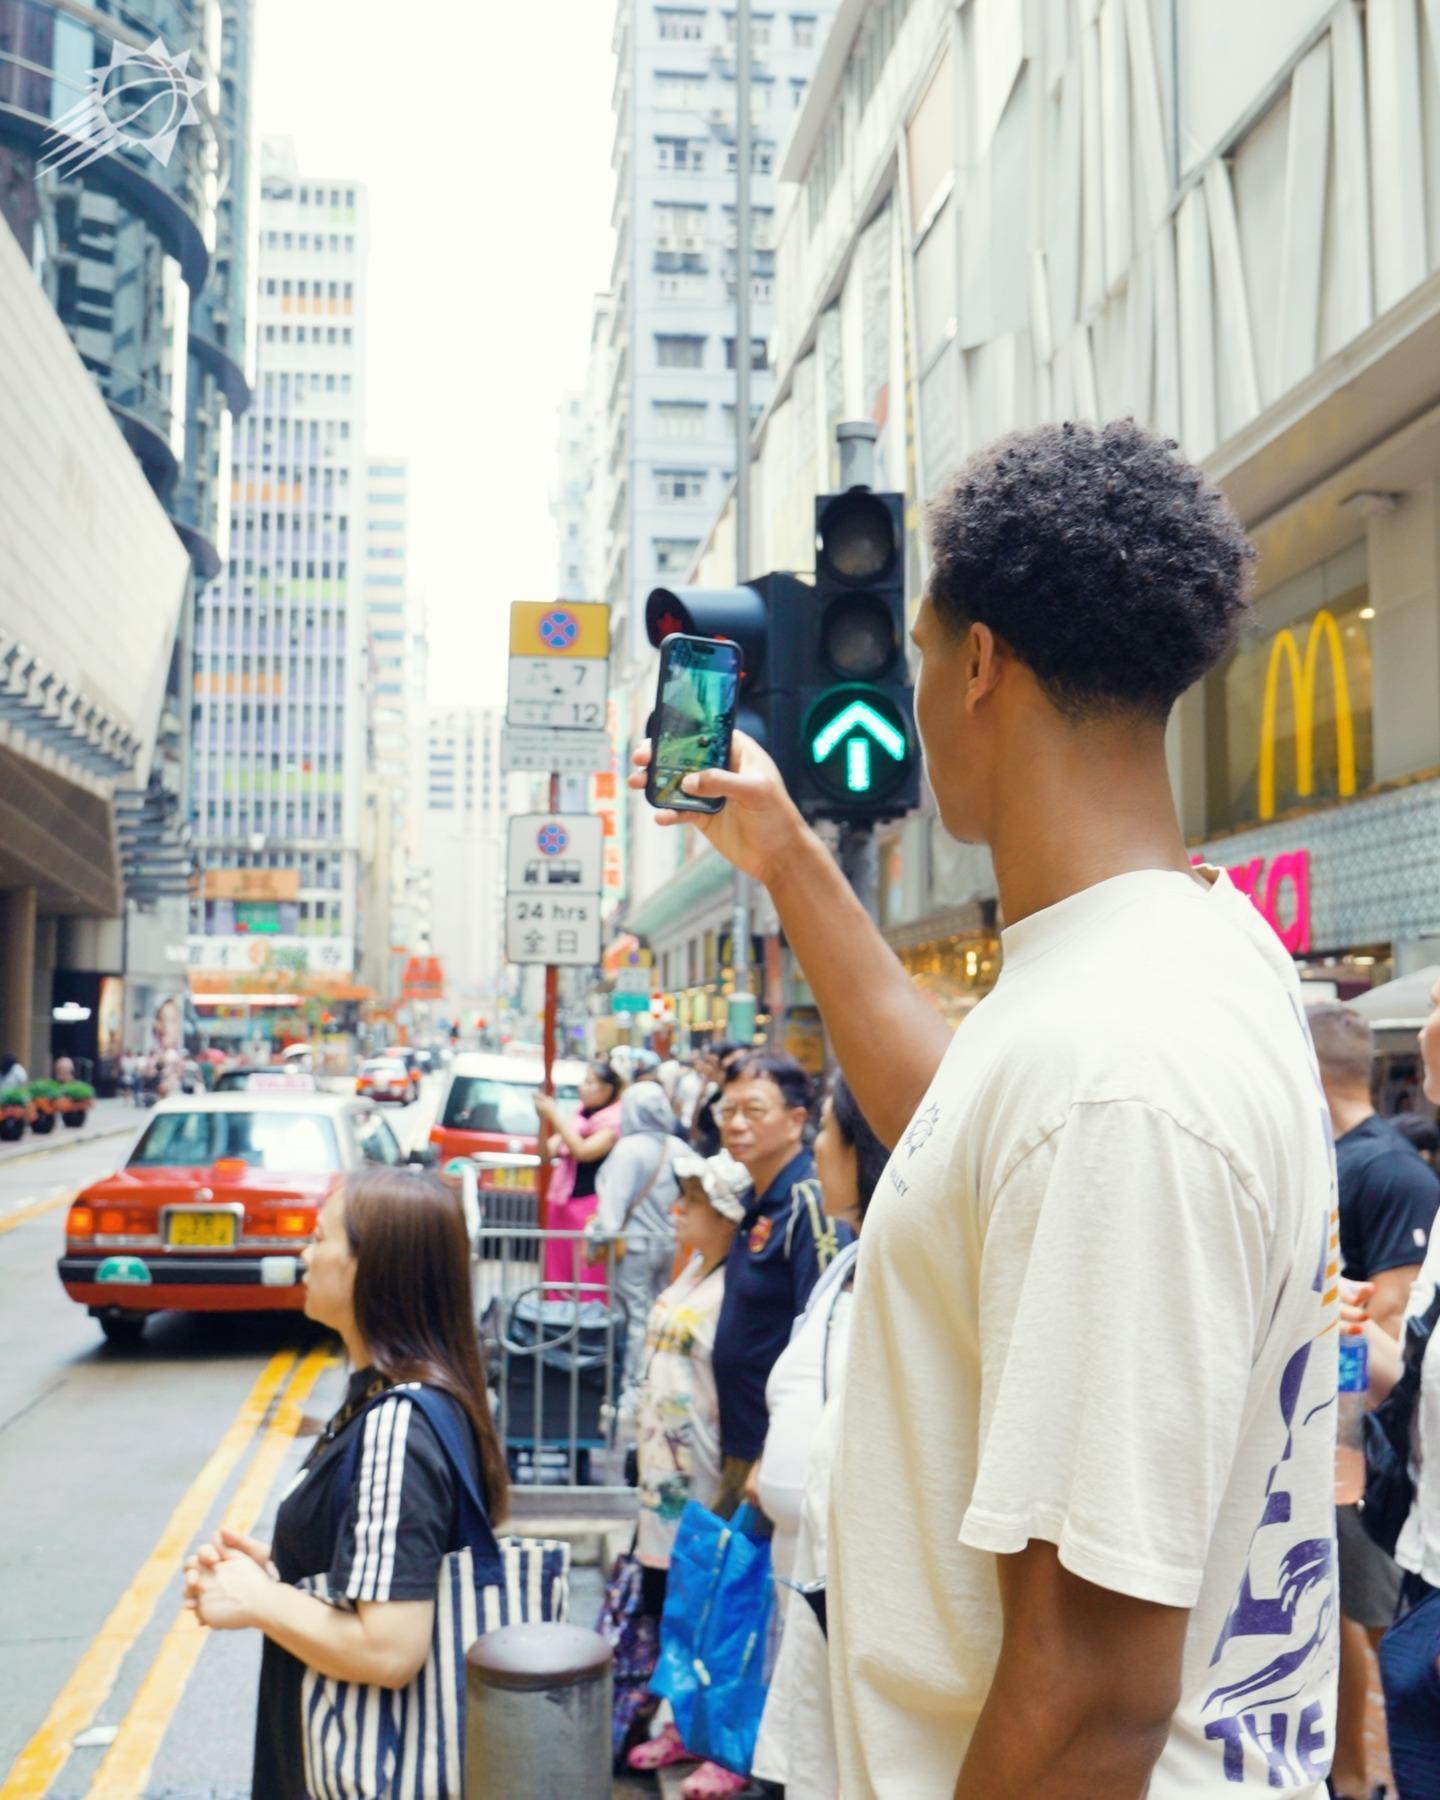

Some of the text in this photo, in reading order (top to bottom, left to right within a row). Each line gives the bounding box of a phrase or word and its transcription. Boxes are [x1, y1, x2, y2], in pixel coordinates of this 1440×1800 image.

[572, 664, 587, 686] 7
[572, 702, 600, 723] 12
[517, 901, 587, 921] 24 hrs
[522, 927, 579, 956] 全日
[1204, 1699, 1332, 1789] THE
